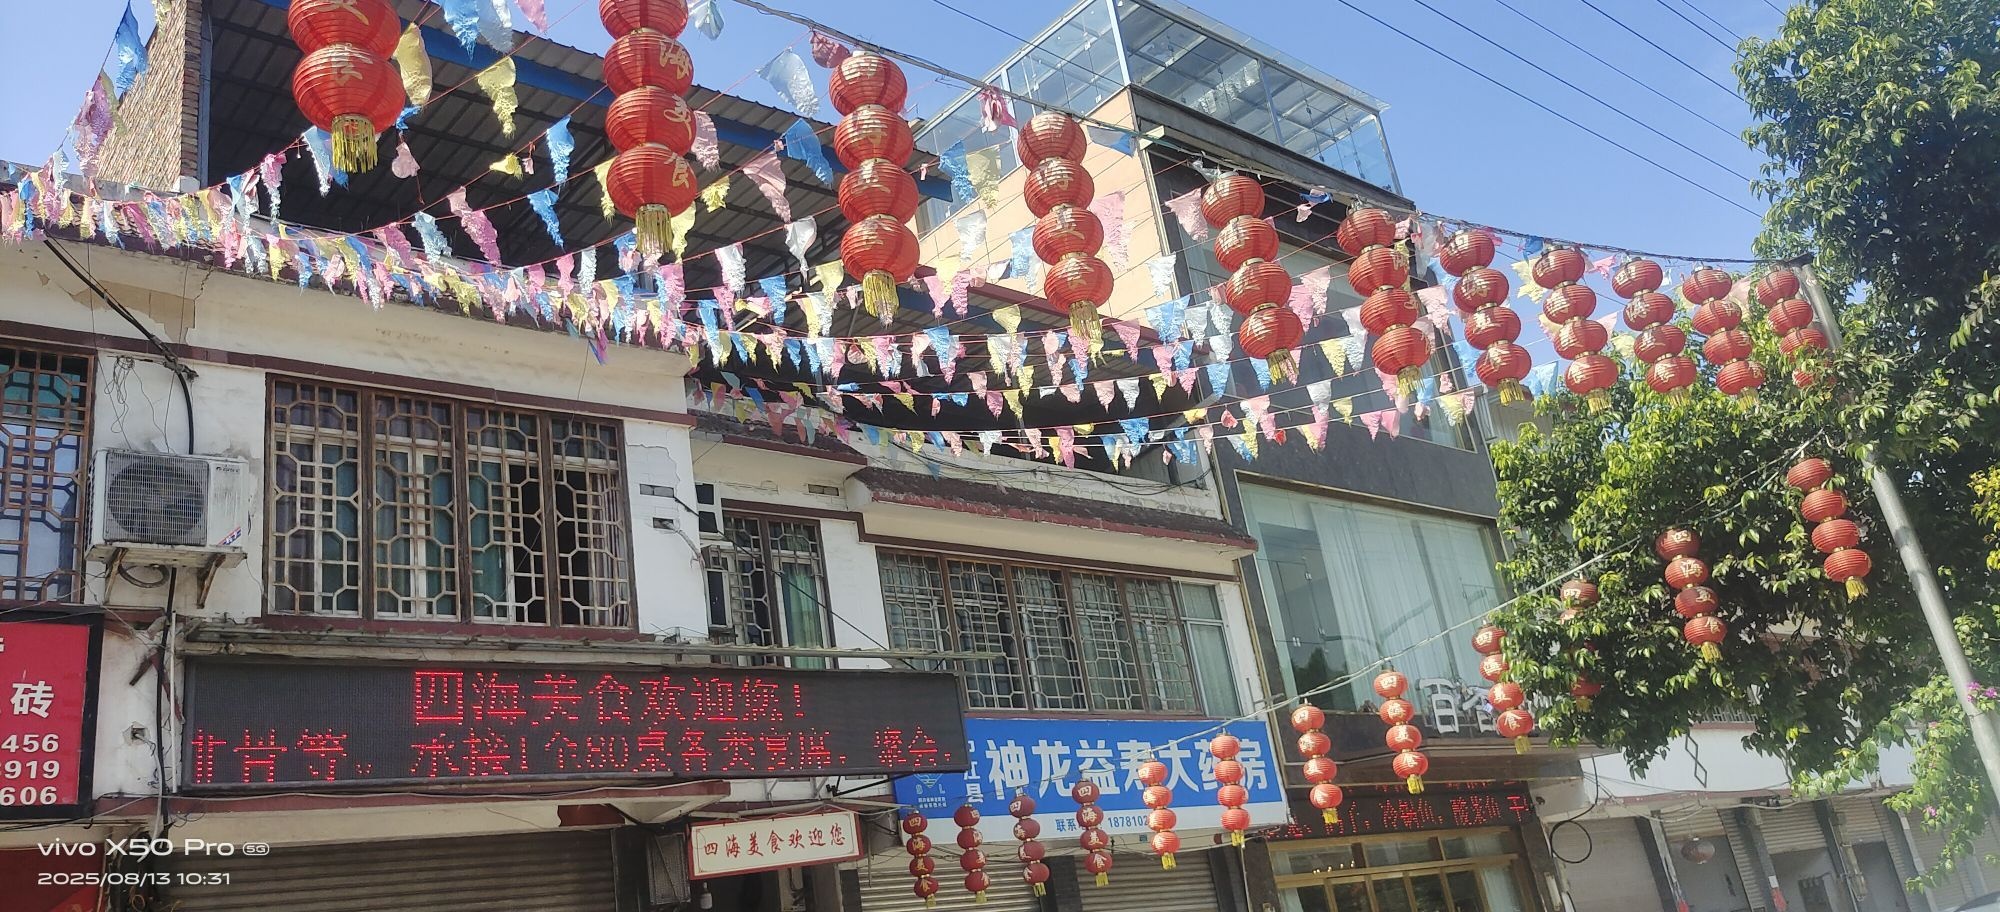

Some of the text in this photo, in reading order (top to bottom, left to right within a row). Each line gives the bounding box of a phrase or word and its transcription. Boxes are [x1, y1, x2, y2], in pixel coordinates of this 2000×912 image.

[10, 680, 54, 718] 砖
[1, 734, 59, 752] 456
[0, 760, 60, 778] 919
[964, 740, 983, 803] 江县
[1108, 815, 1150, 828] 1878102
[704, 823, 846, 858] 四海美食欢迎您
